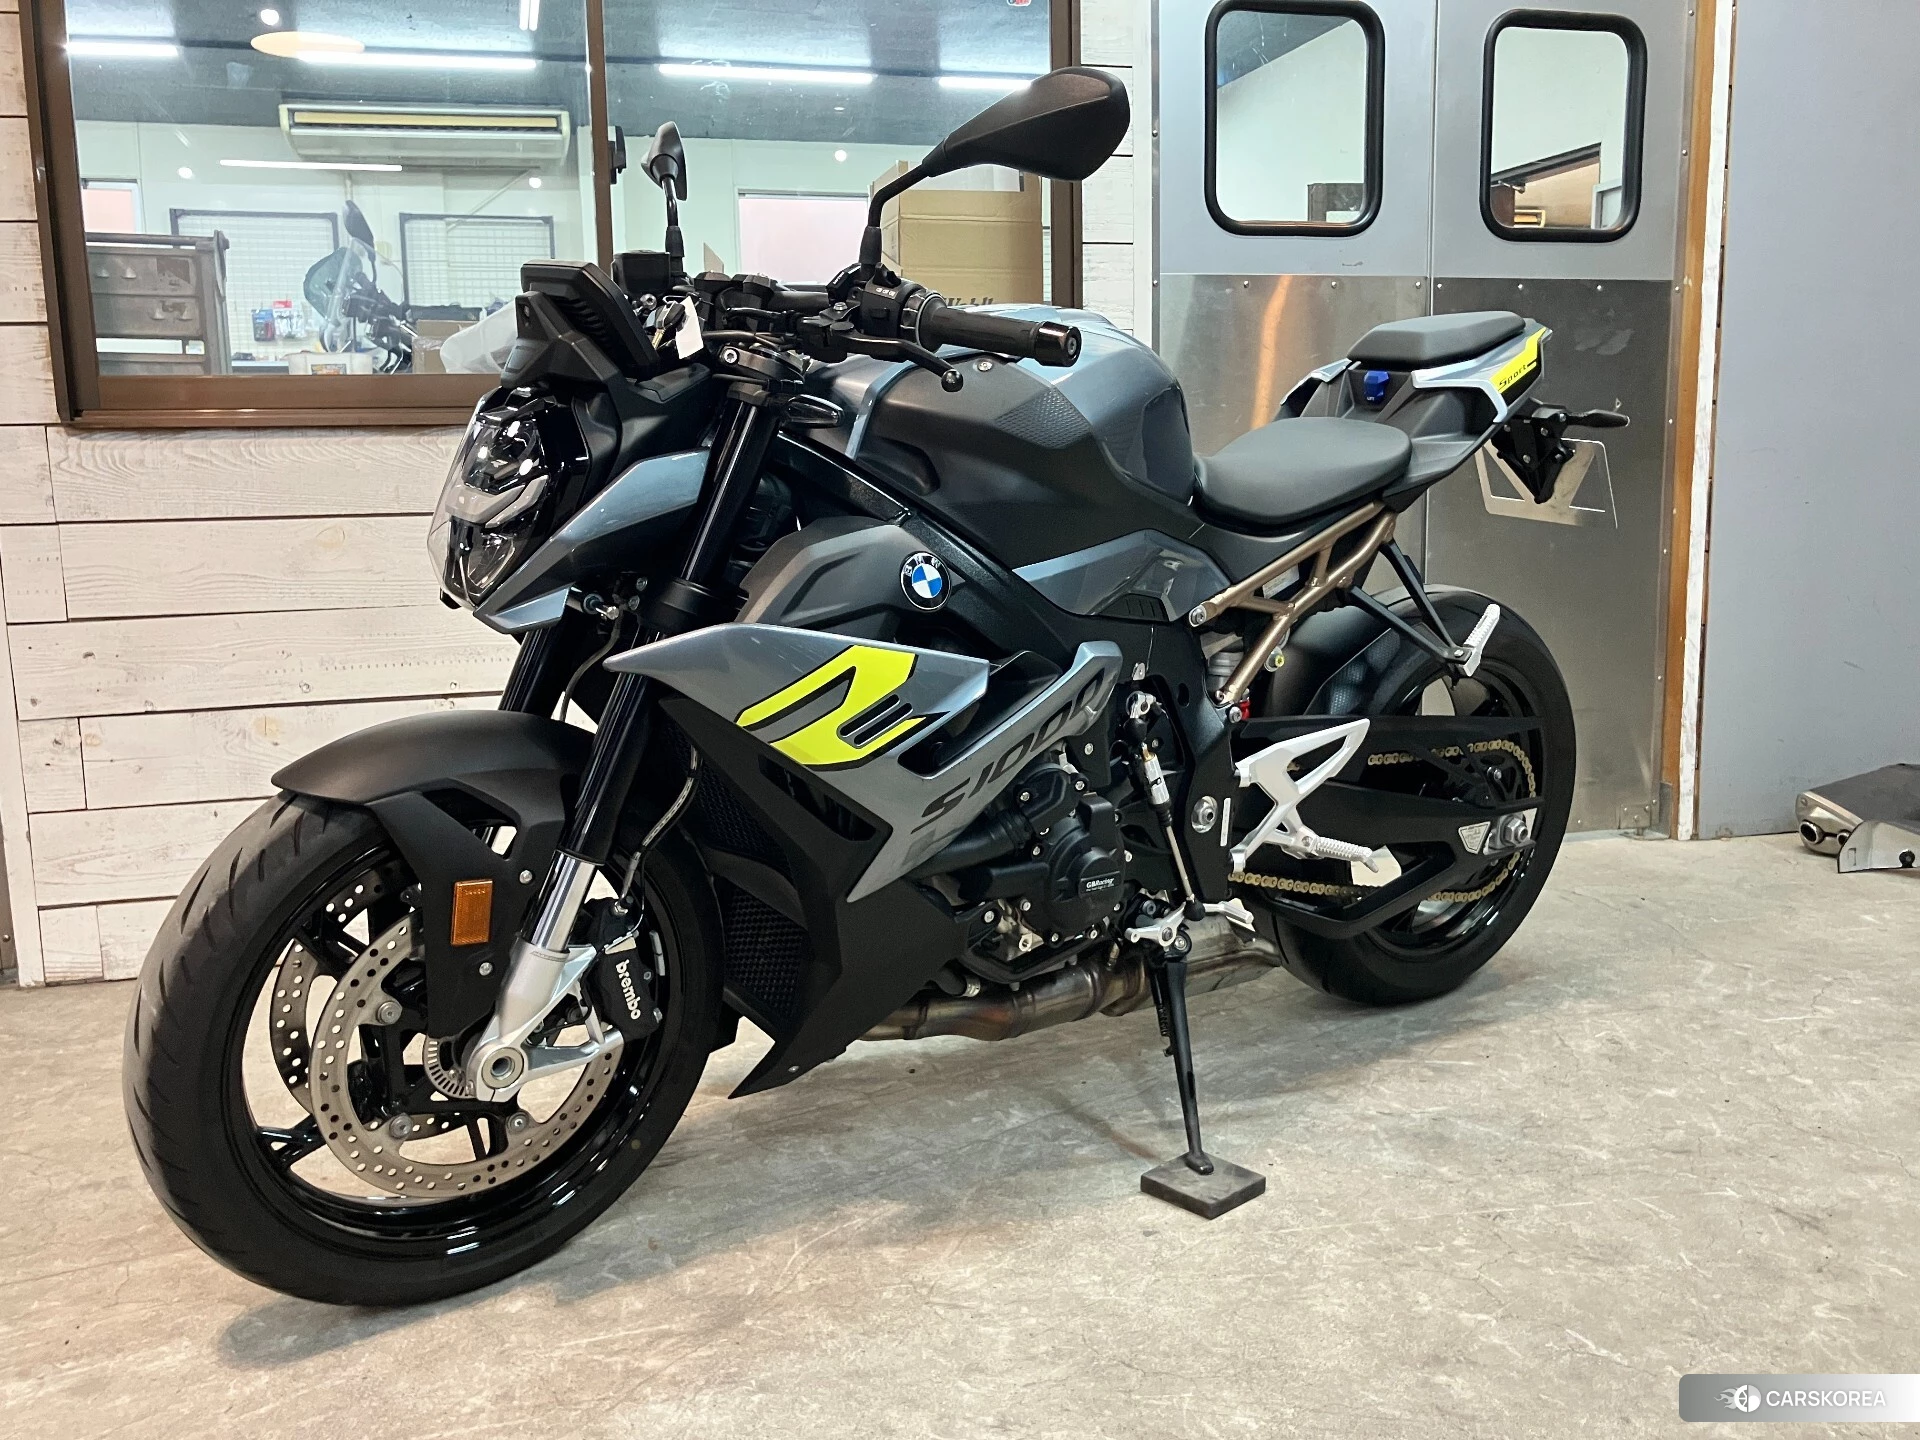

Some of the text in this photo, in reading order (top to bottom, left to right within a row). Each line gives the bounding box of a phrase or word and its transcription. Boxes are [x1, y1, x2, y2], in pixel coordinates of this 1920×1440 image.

[1498, 364, 1526, 391] Sport
[903, 554, 941, 577] BMW
[911, 667, 1106, 834] S1000
[615, 959, 641, 1020] brembo
